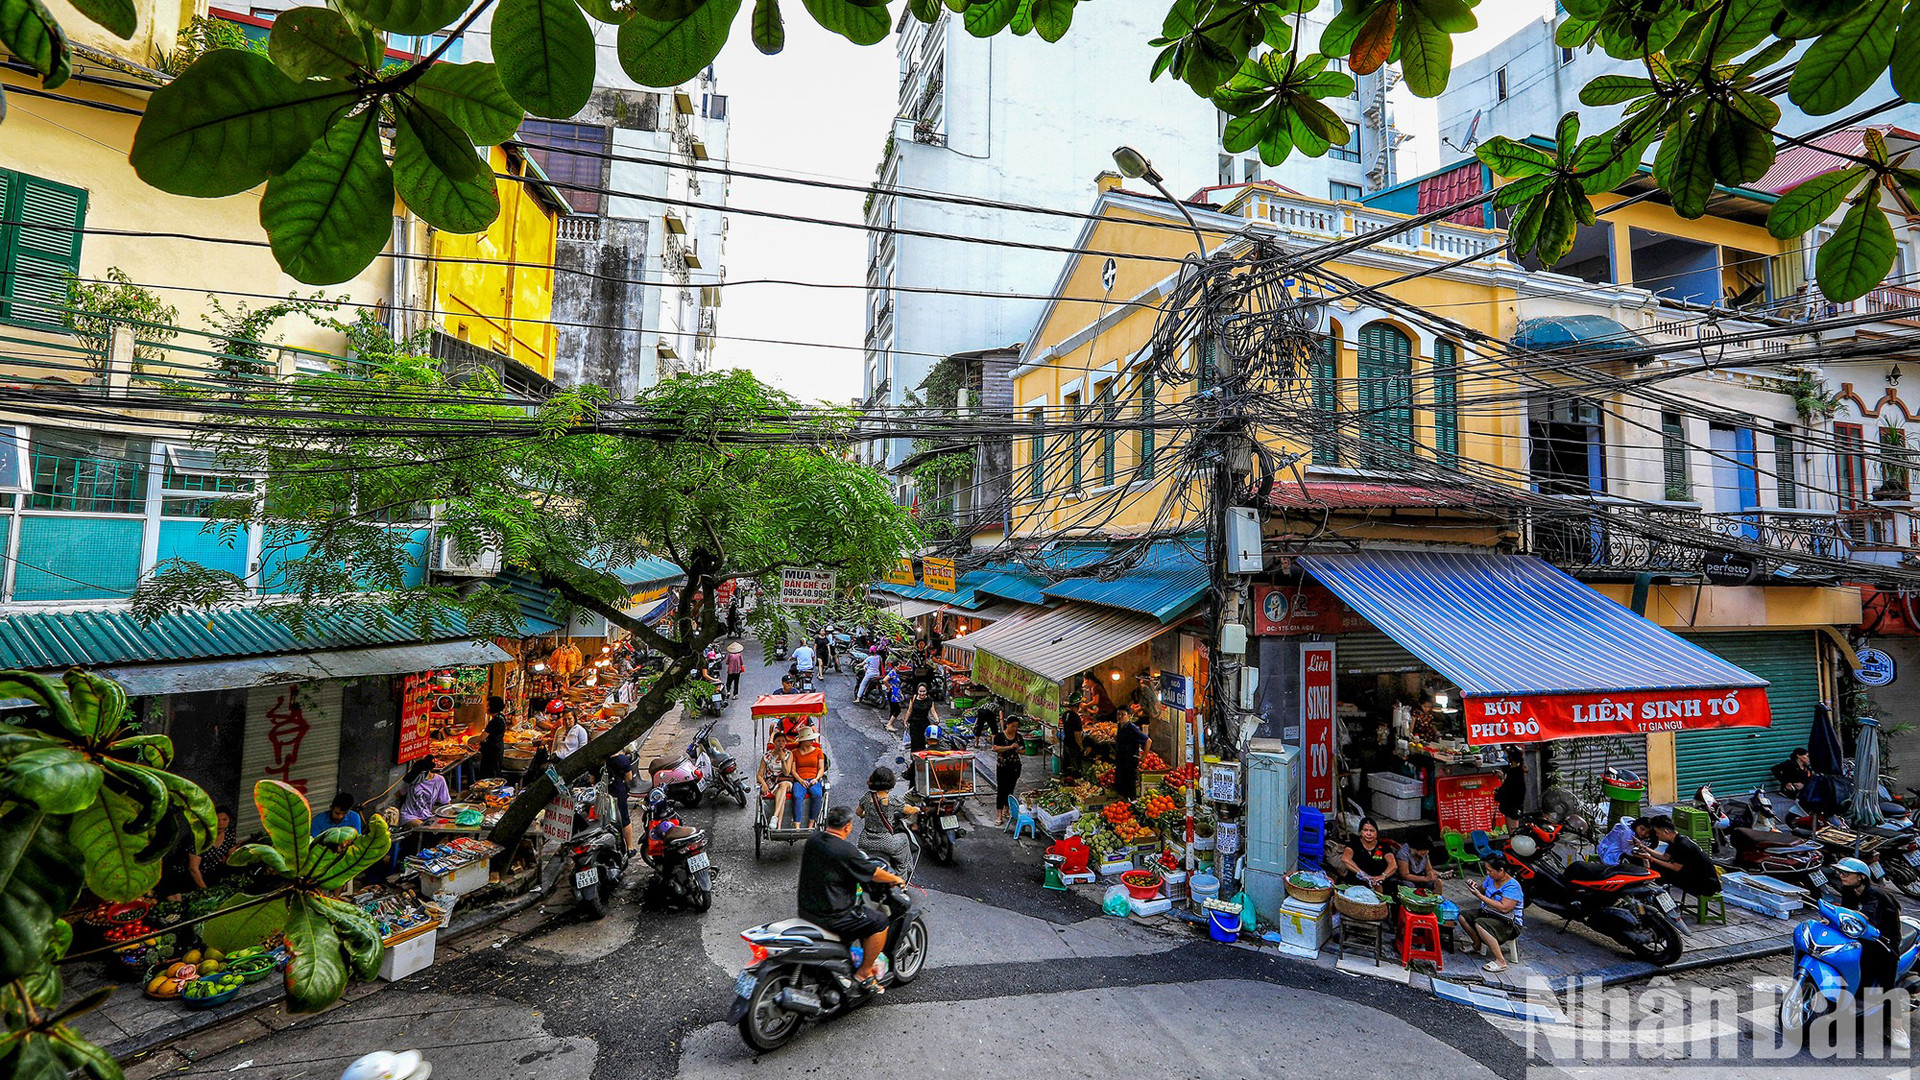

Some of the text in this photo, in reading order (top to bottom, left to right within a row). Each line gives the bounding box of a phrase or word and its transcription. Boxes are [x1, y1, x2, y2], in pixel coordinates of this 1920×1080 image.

[785, 570, 811, 580] MUA
[1706, 564, 1750, 574] perfetto
[784, 579, 801, 588] BÀN
[1312, 633, 1321, 641] 17
[1307, 654, 1329, 672] Liên
[1307, 686, 1330, 720] SINH
[1484, 698, 1521, 716] BÚN
[1572, 690, 1740, 723] LIÊN SINH TỐ
[1471, 717, 1539, 738] PHÚ ĐÔ
[1637, 722, 1647, 732] 17
[1648, 721, 1664, 731] GIA
[1310, 726, 1328, 777] TỐ
[1314, 788, 1325, 799] 17
